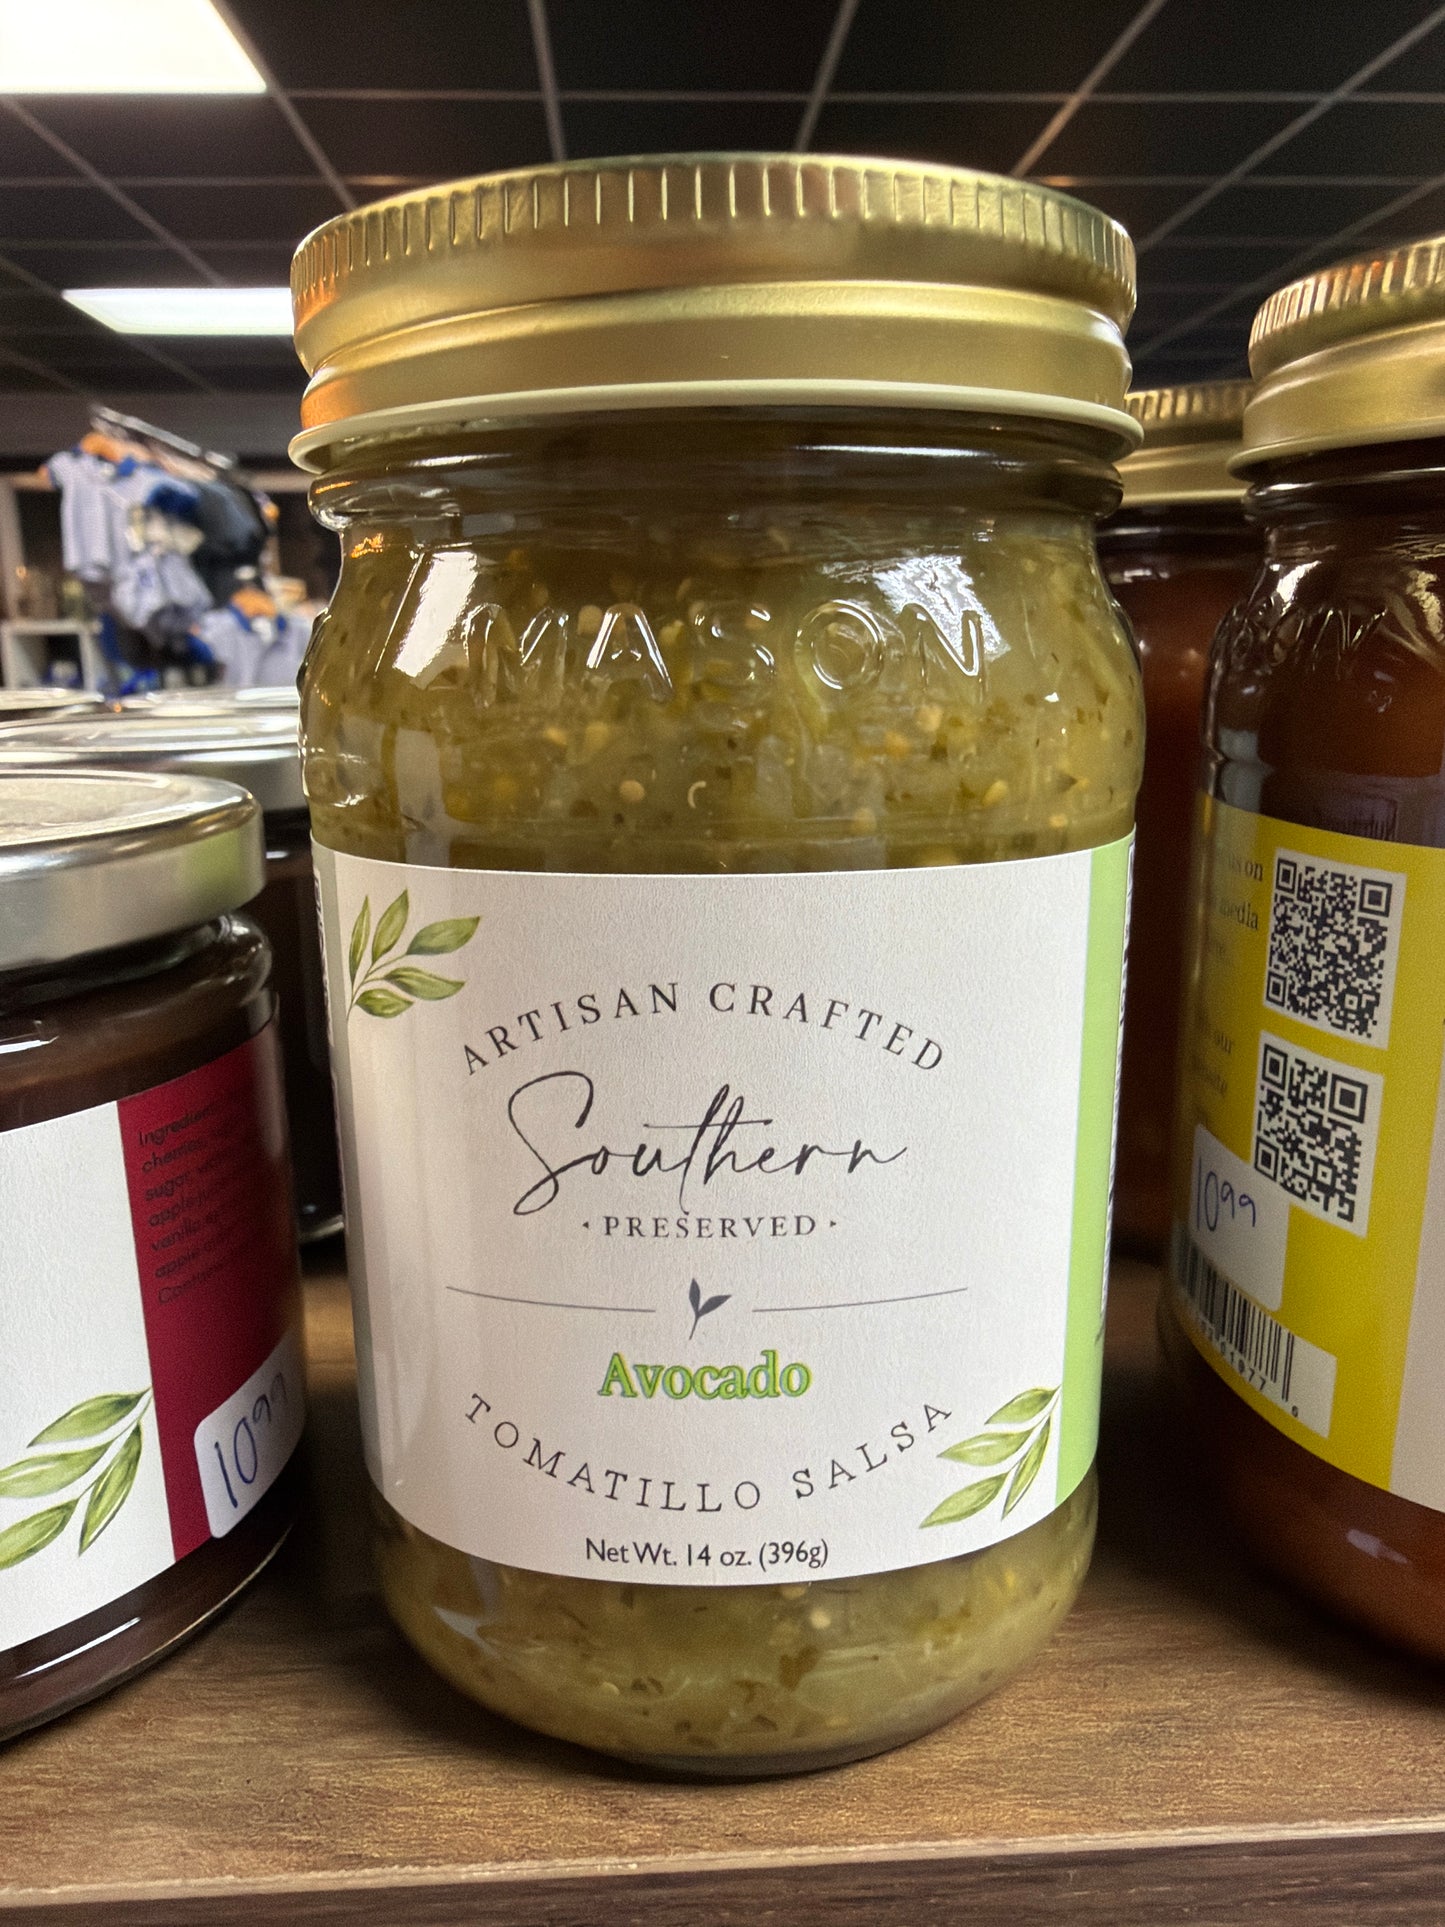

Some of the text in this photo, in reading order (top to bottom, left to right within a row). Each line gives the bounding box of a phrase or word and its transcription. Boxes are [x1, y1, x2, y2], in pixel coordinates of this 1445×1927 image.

[462, 600, 986, 700] MASON
[1245, 859, 1264, 883] on
[464, 982, 944, 1076] ARTISAN CRAFTED
[508, 1070, 907, 1217] Southern
[603, 1214, 817, 1239] PRESERVED
[599, 1349, 811, 1402] Avocado
[465, 1392, 954, 1514] TOMATILLO SALSA
[585, 1537, 829, 1573] Net Wt. 14 oz. (396g)
